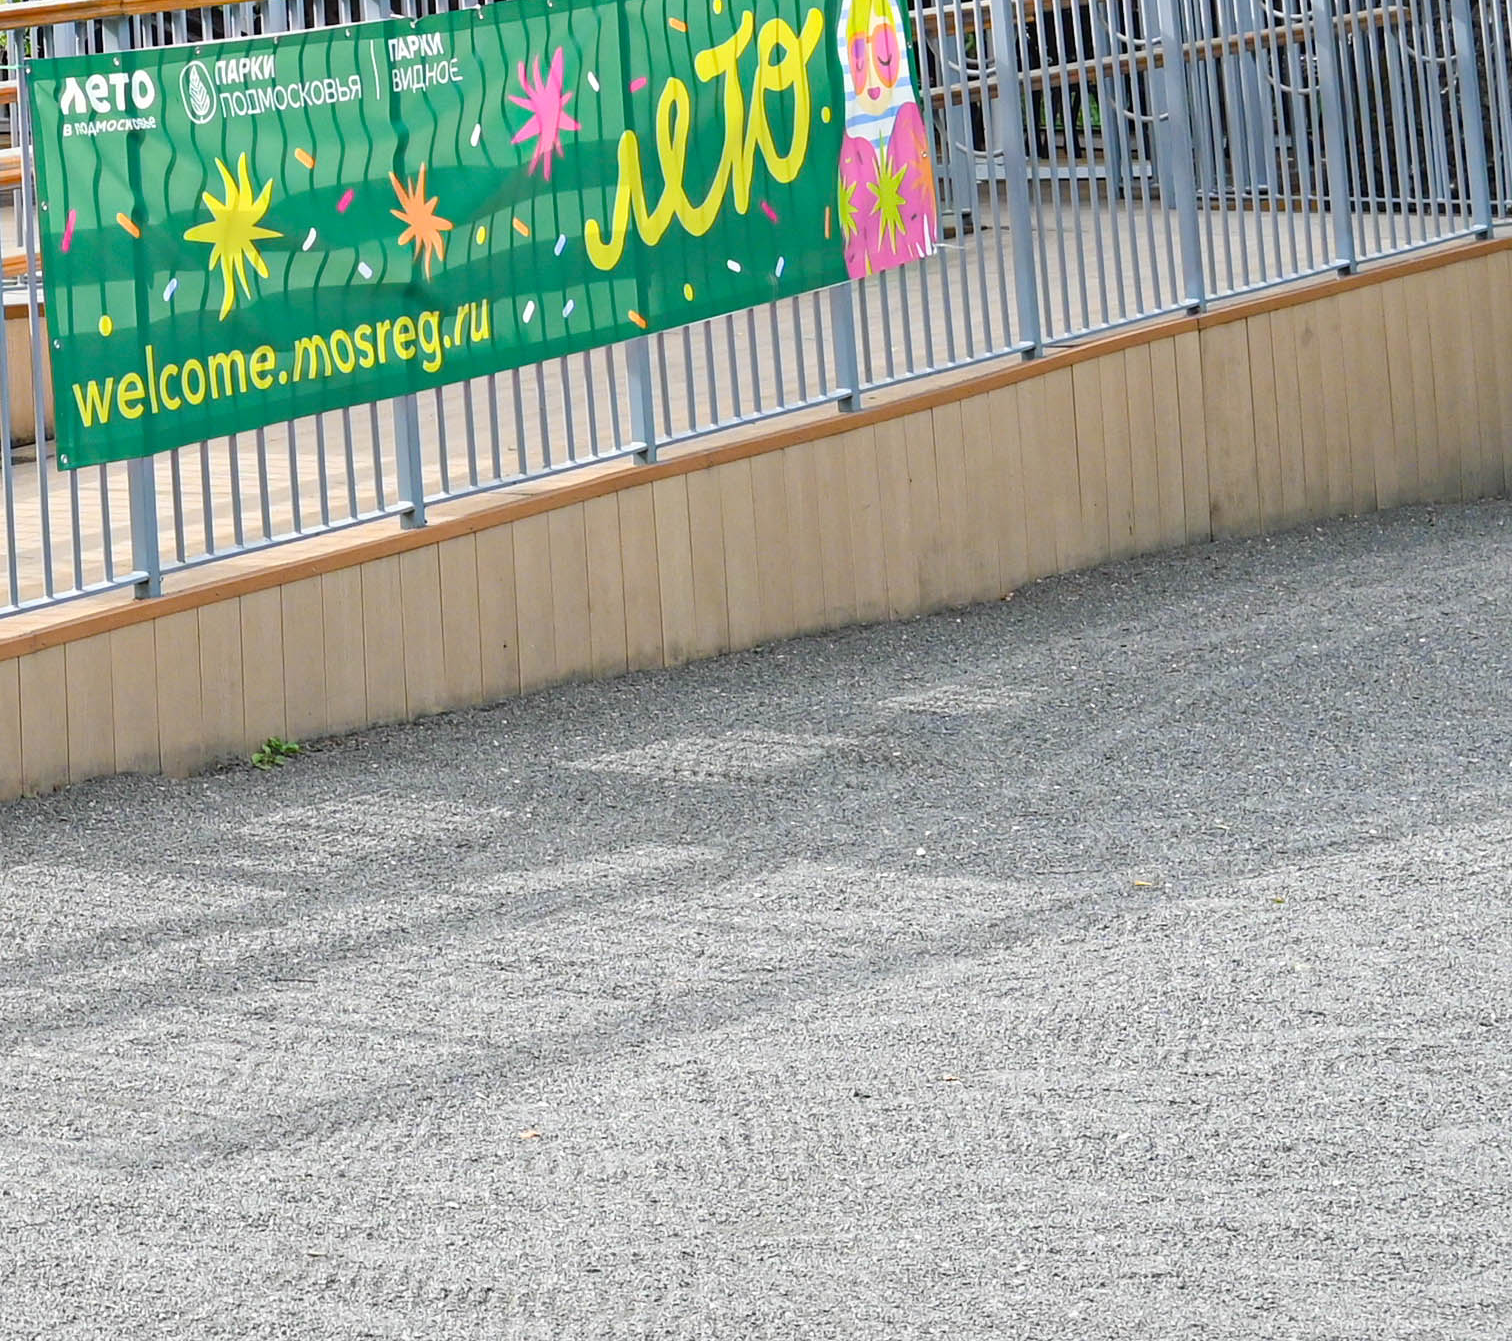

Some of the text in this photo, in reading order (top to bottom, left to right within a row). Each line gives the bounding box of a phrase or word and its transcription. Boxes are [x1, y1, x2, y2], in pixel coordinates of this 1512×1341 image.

[388, 31, 445, 63] ПАРКИ
[214, 54, 276, 86] ПАРКИ
[392, 57, 463, 94] ВИДНОЕ
[219, 74, 362, 119] ПОДМОСКОВЬЯ
[72, 298, 492, 429] welcome.mosreg.ru
